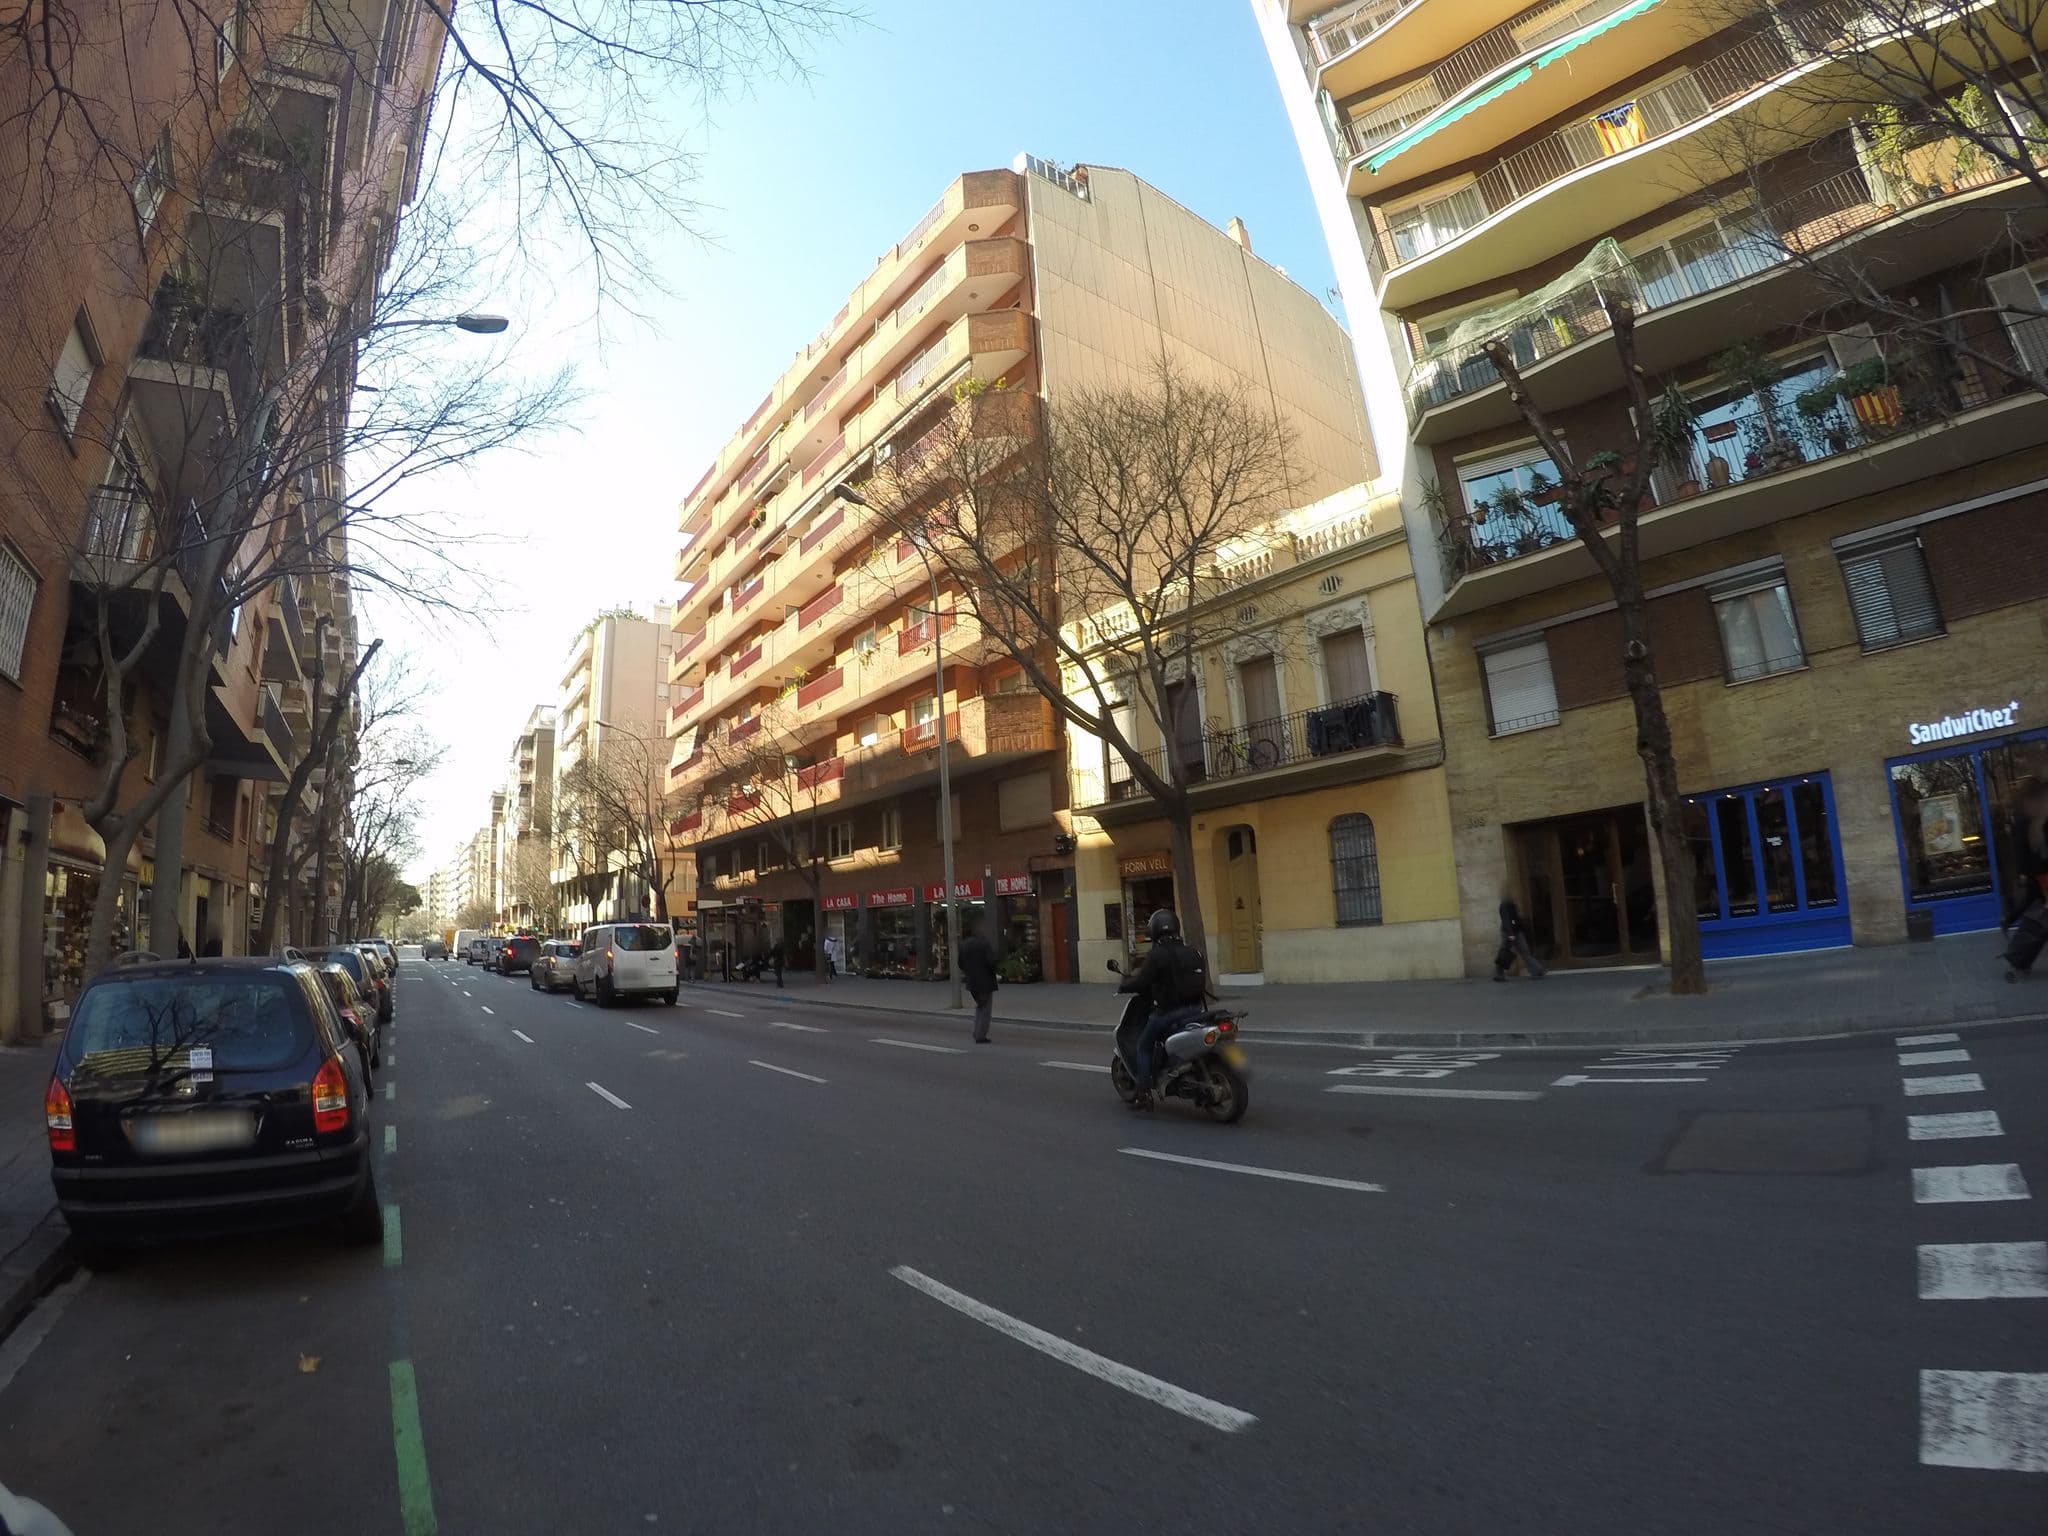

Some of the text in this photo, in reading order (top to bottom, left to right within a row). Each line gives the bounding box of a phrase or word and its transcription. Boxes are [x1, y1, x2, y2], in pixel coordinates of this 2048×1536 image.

[1909, 706, 2015, 745] SandwiChez
[1124, 858, 1168, 873] FORN VELL
[872, 893, 907, 905] The Home
[933, 884, 972, 899] LA ASA
[826, 899, 834, 908] LA
